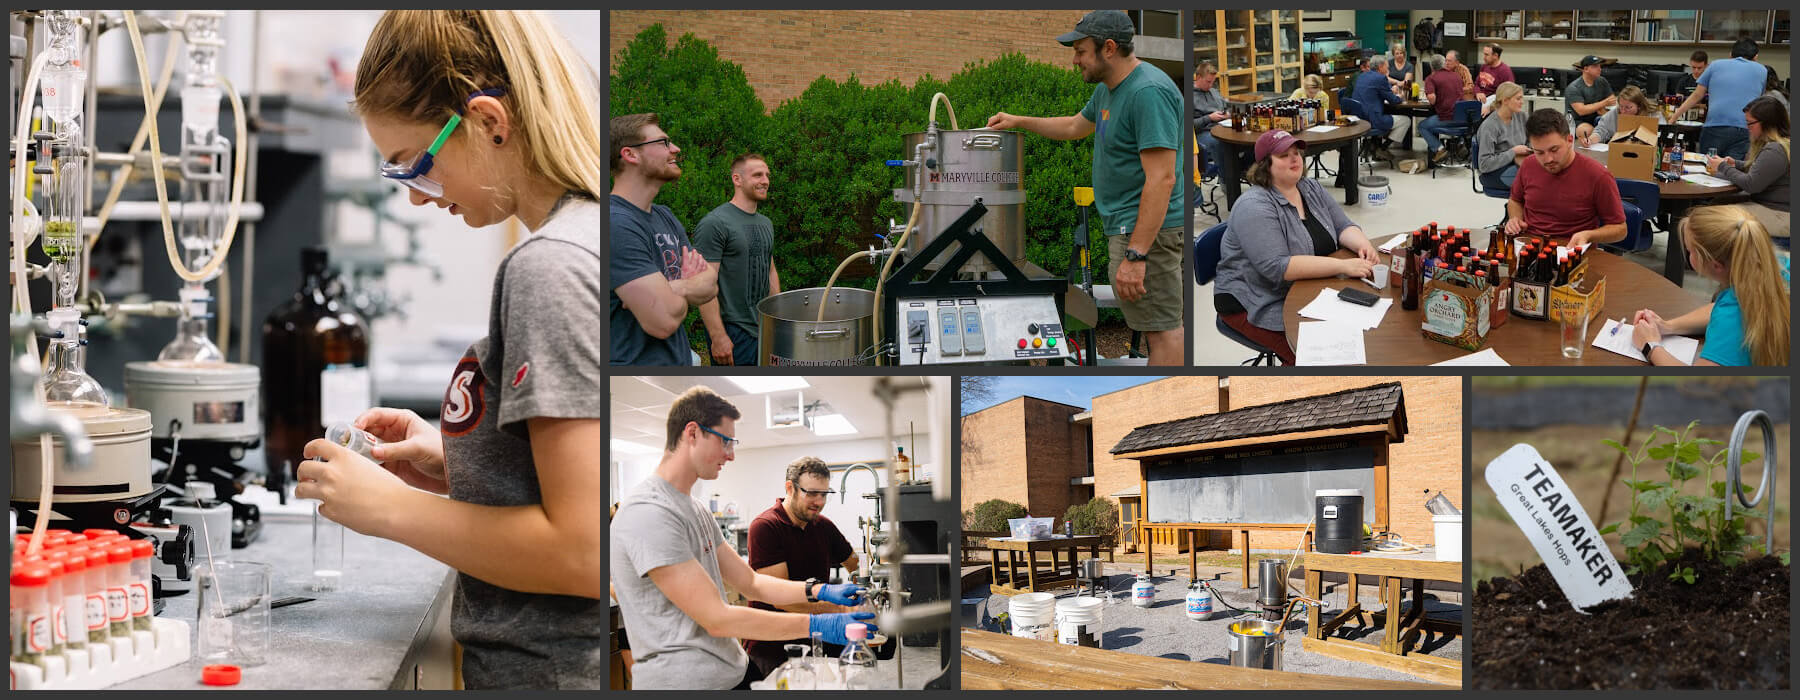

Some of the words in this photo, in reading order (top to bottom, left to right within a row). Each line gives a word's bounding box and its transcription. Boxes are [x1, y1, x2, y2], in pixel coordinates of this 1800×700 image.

[942, 172, 990, 183] MARYVILLE
[1429, 306, 1461, 320] ORCHARD
[1434, 303, 1456, 312] ANGRY
[443, 370, 476, 423] S
[1510, 483, 1533, 511] Great
[1532, 510, 1554, 540] Lakes
[1552, 539, 1571, 566] Hops
[1524, 463, 1613, 587] TEAMAKER
